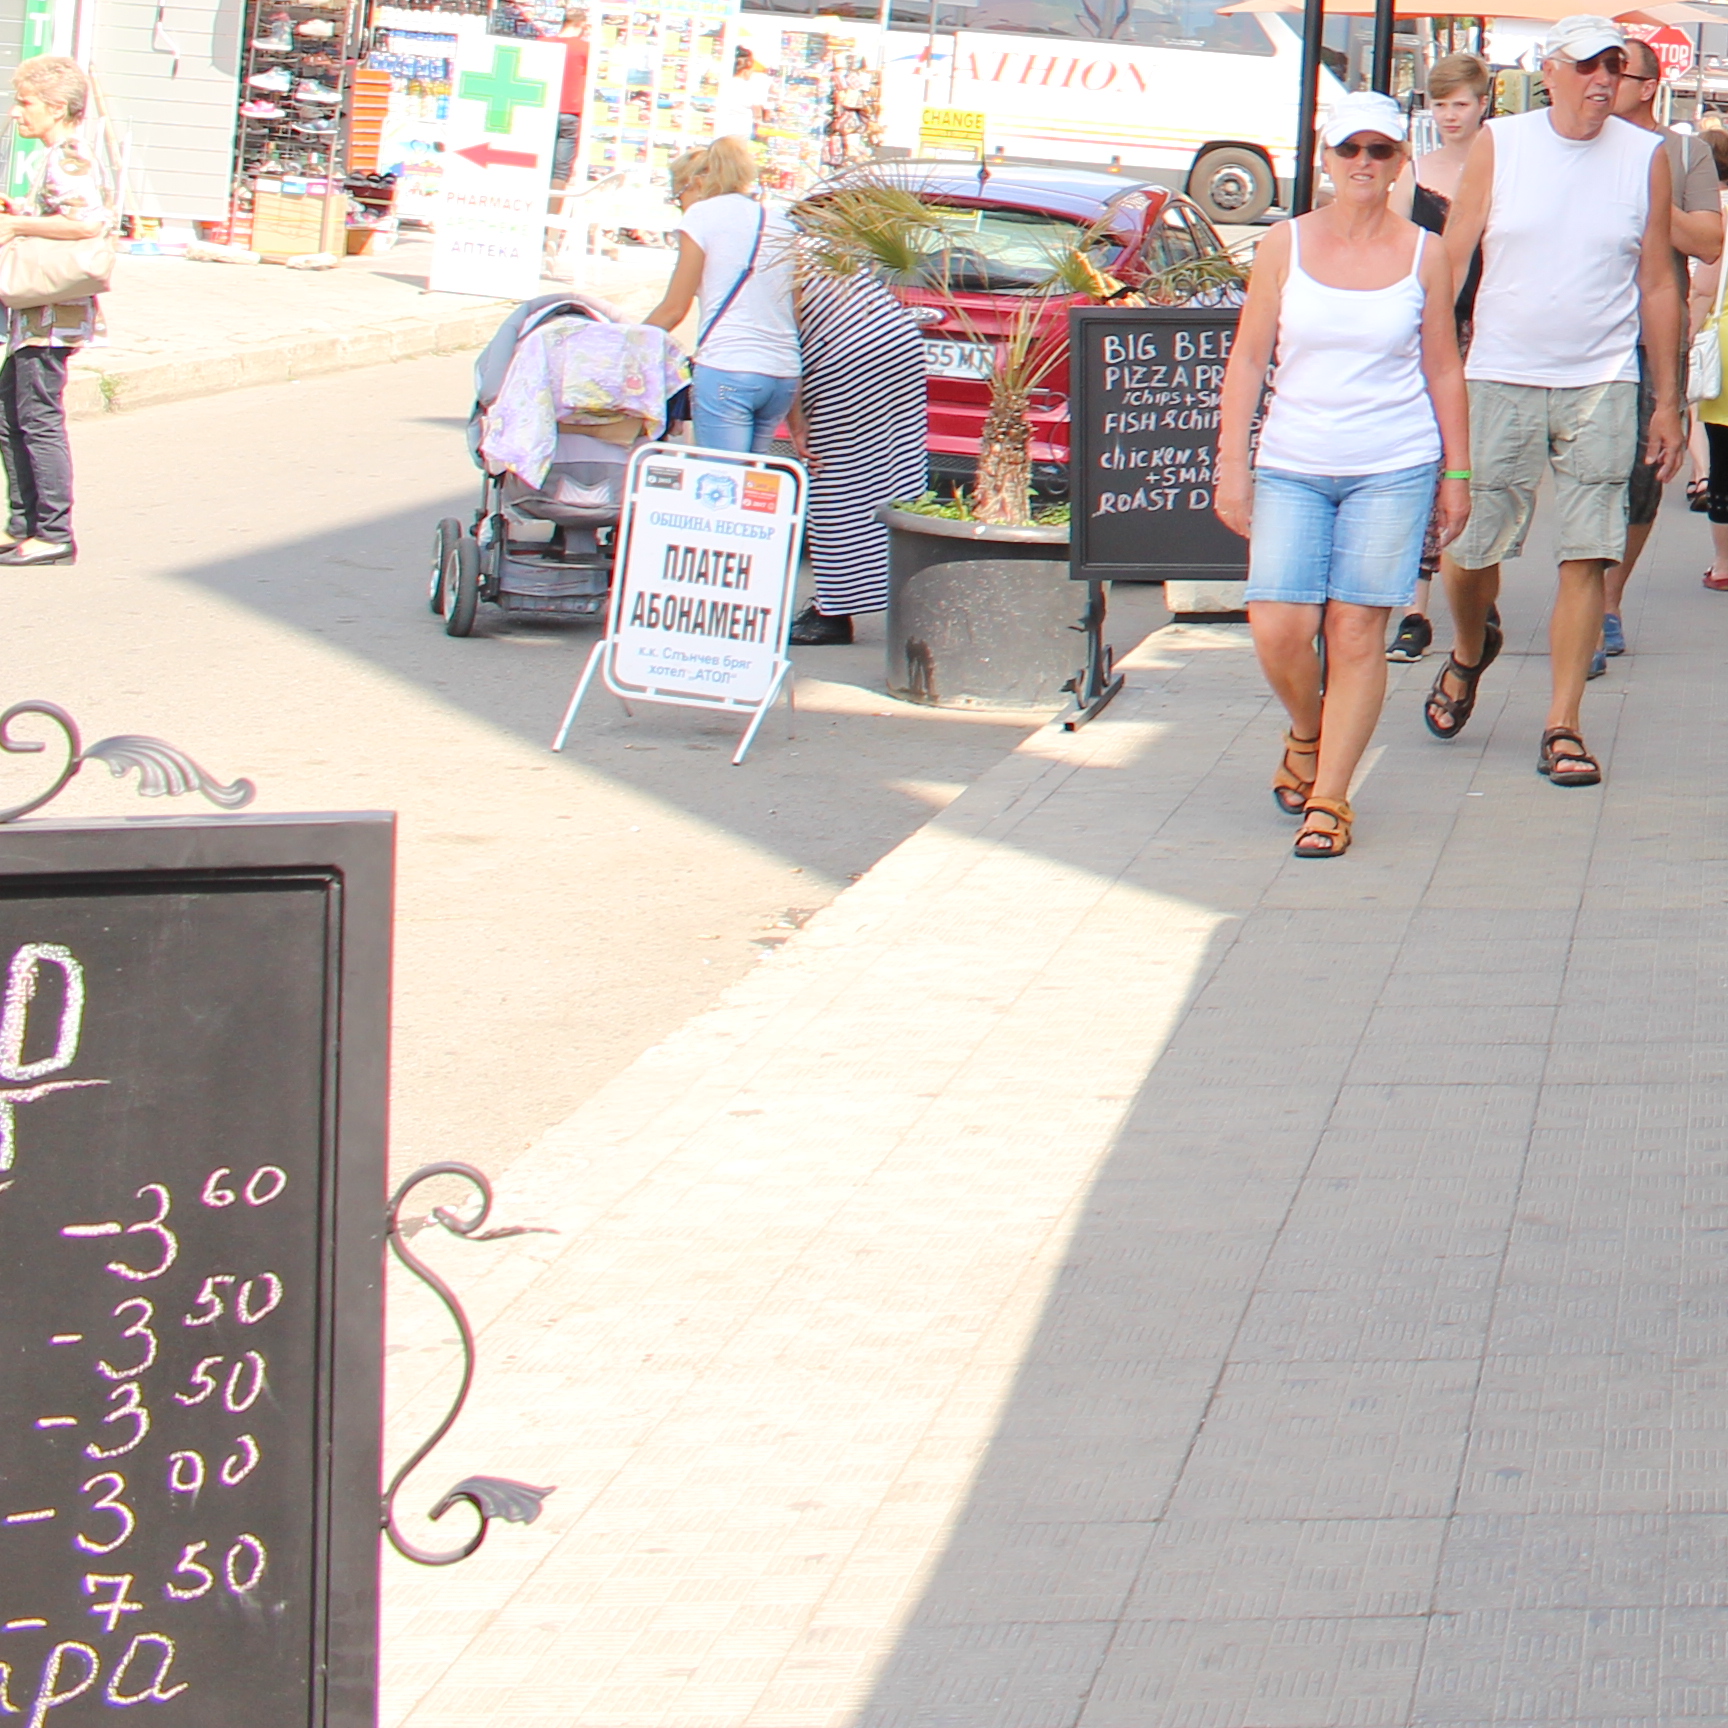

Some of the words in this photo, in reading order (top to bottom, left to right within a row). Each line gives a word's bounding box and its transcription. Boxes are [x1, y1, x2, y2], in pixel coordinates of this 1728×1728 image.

[922, 110, 984, 130] CHANGE
[447, 191, 534, 212] PHARMACY
[451, 240, 519, 258] АПТЕКА
[1104, 332, 1158, 364] BIG
[1105, 365, 1190, 391] PIZZA
[1104, 411, 1157, 435] FISH
[1095, 486, 1182, 517] ROAST
[649, 510, 712, 534] ОБЩИНА
[715, 518, 776, 541] НЕСЕБЪР
[661, 543, 753, 591] ПЛАТЕН
[629, 590, 773, 644] АБОНАМЕНТ
[662, 646, 720, 666] Слънчев
[722, 654, 753, 671] бряг
[648, 664, 683, 679] хотел
